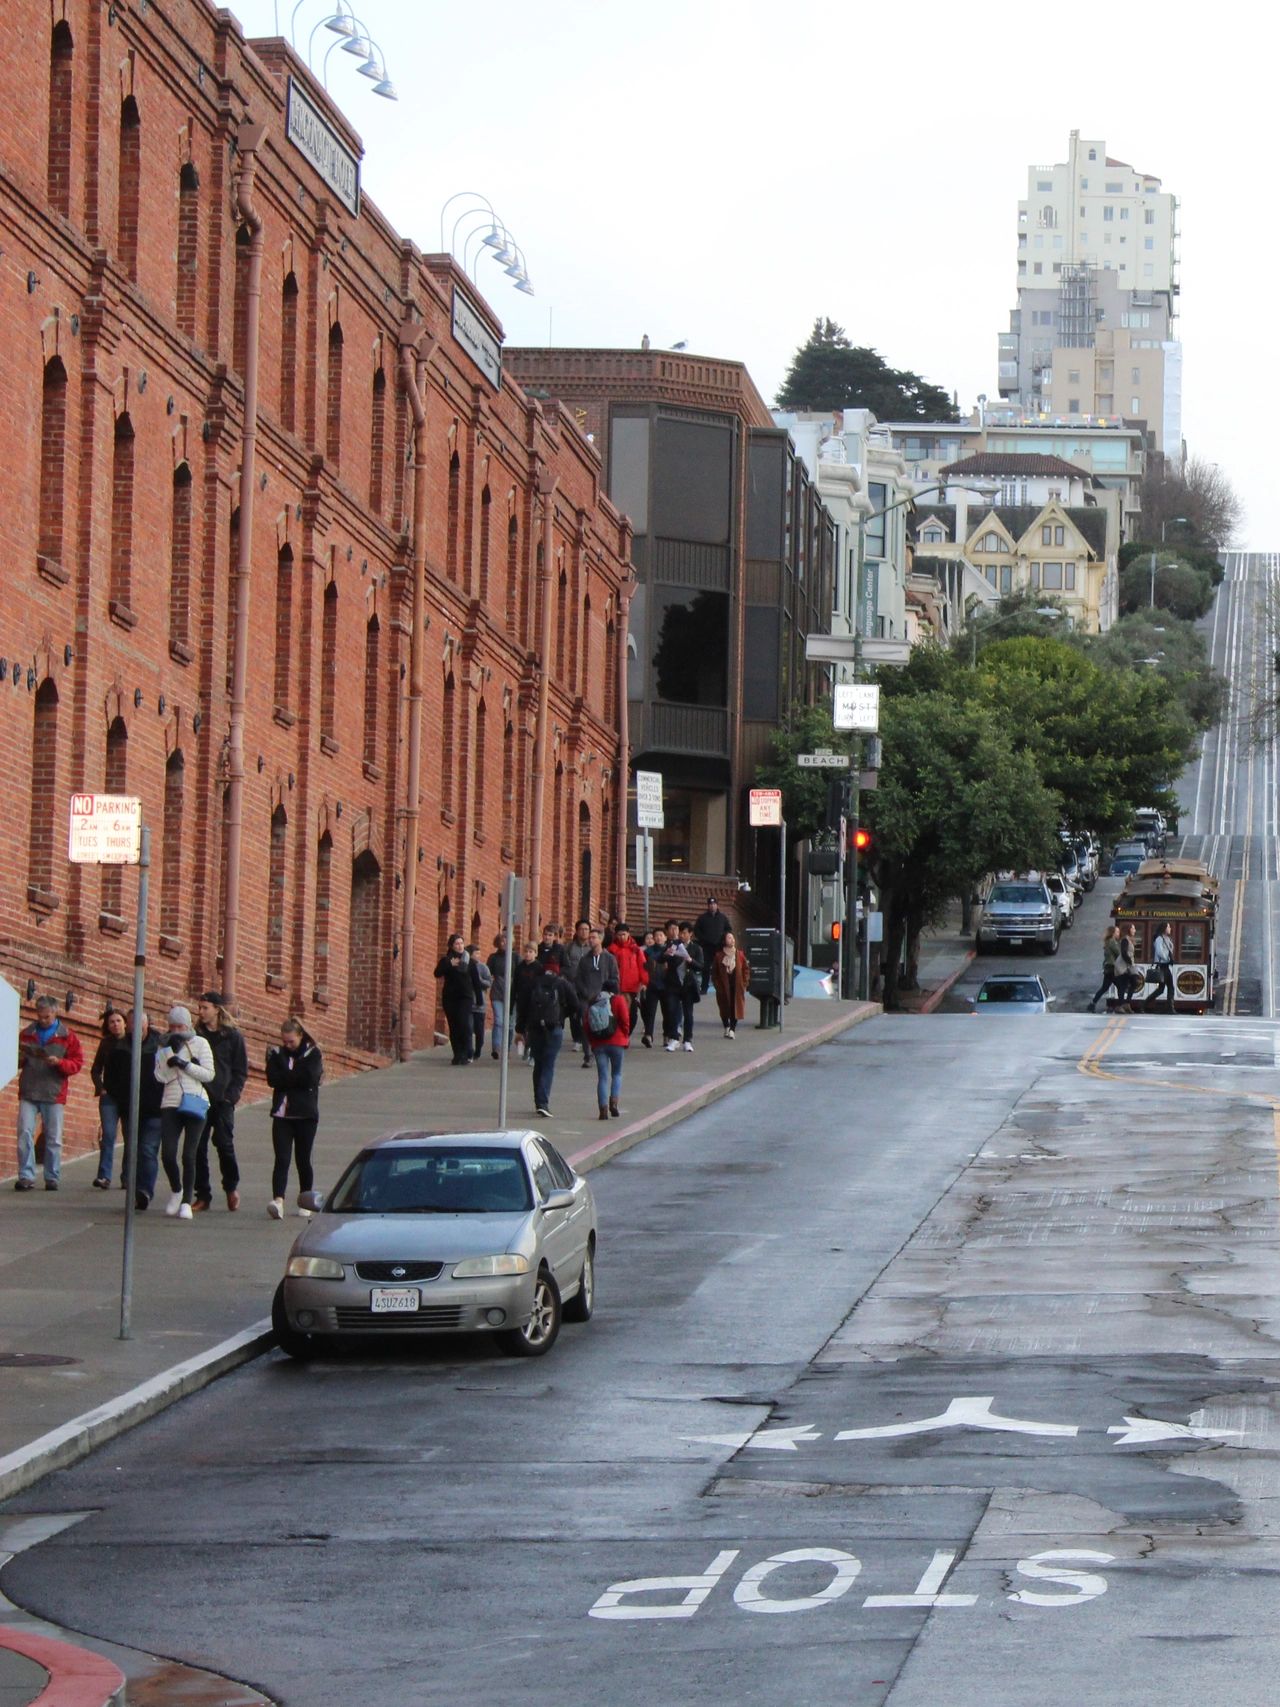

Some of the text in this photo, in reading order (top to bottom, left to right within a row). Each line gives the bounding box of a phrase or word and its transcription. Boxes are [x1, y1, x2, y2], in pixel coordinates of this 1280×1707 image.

[865, 600, 874, 638] anguage
[803, 756, 844, 765] BEACH
[74, 796, 136, 814] NO PARKING
[79, 836, 131, 848] TUES THURS
[375, 1297, 416, 1309] 4SUZ618
[588, 1547, 1116, 1621] STOP
